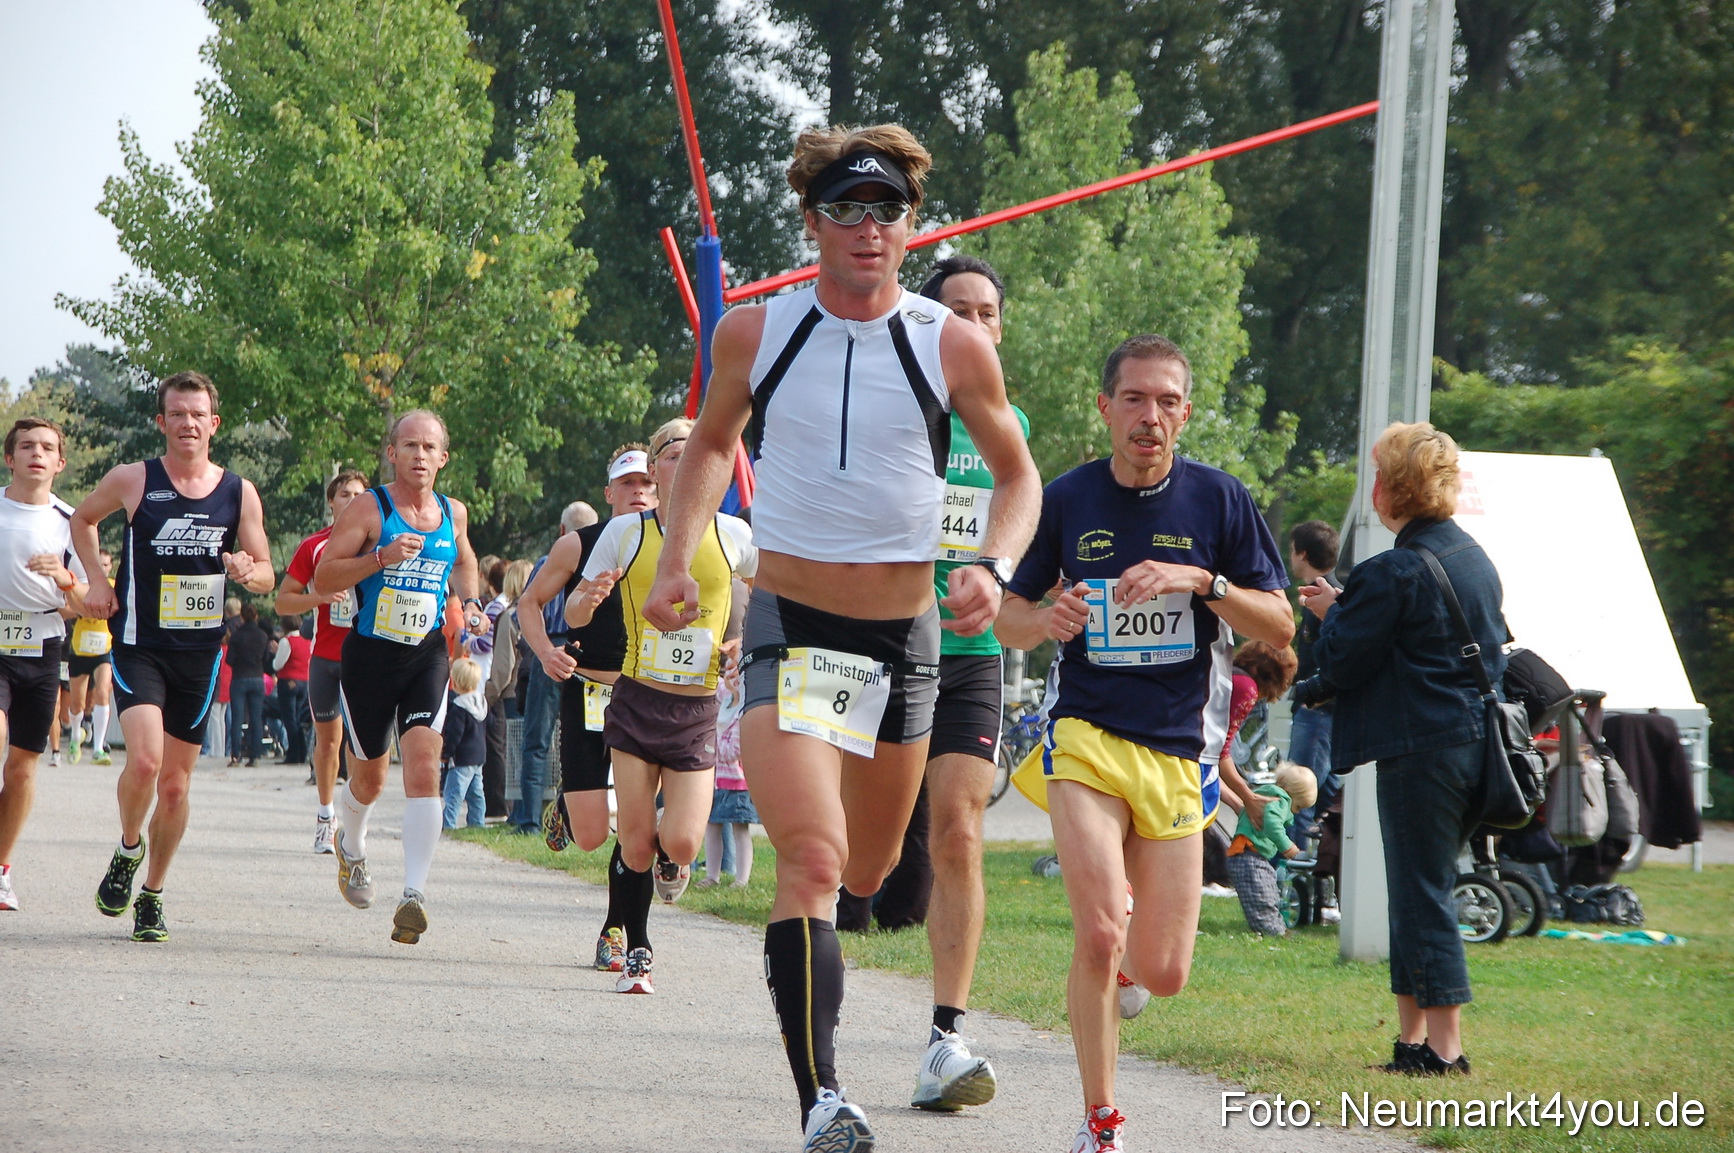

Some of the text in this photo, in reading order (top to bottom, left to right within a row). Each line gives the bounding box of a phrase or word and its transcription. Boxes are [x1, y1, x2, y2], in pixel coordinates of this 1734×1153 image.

[942, 514, 978, 538] 444
[156, 546, 173, 556] SC
[177, 546, 206, 556] Roth
[180, 580, 208, 591] Martin
[383, 576, 441, 591] TSG 08 Roth
[163, 595, 168, 603] A
[185, 595, 215, 611] 966
[395, 594, 421, 607] Dieter
[379, 605, 384, 613] A
[0, 611, 23, 621] Daniel
[400, 611, 427, 628] 119
[1089, 612, 1095, 624] A
[1115, 610, 1183, 636] 2007
[4, 626, 34, 640] 173
[661, 631, 693, 642] Marius
[643, 643, 648, 652] A
[672, 648, 694, 665] 92
[1152, 649, 1193, 659] PFLEIDERER
[813, 655, 880, 686] Christoph
[785, 677, 791, 688] A
[832, 689, 850, 714] 8
